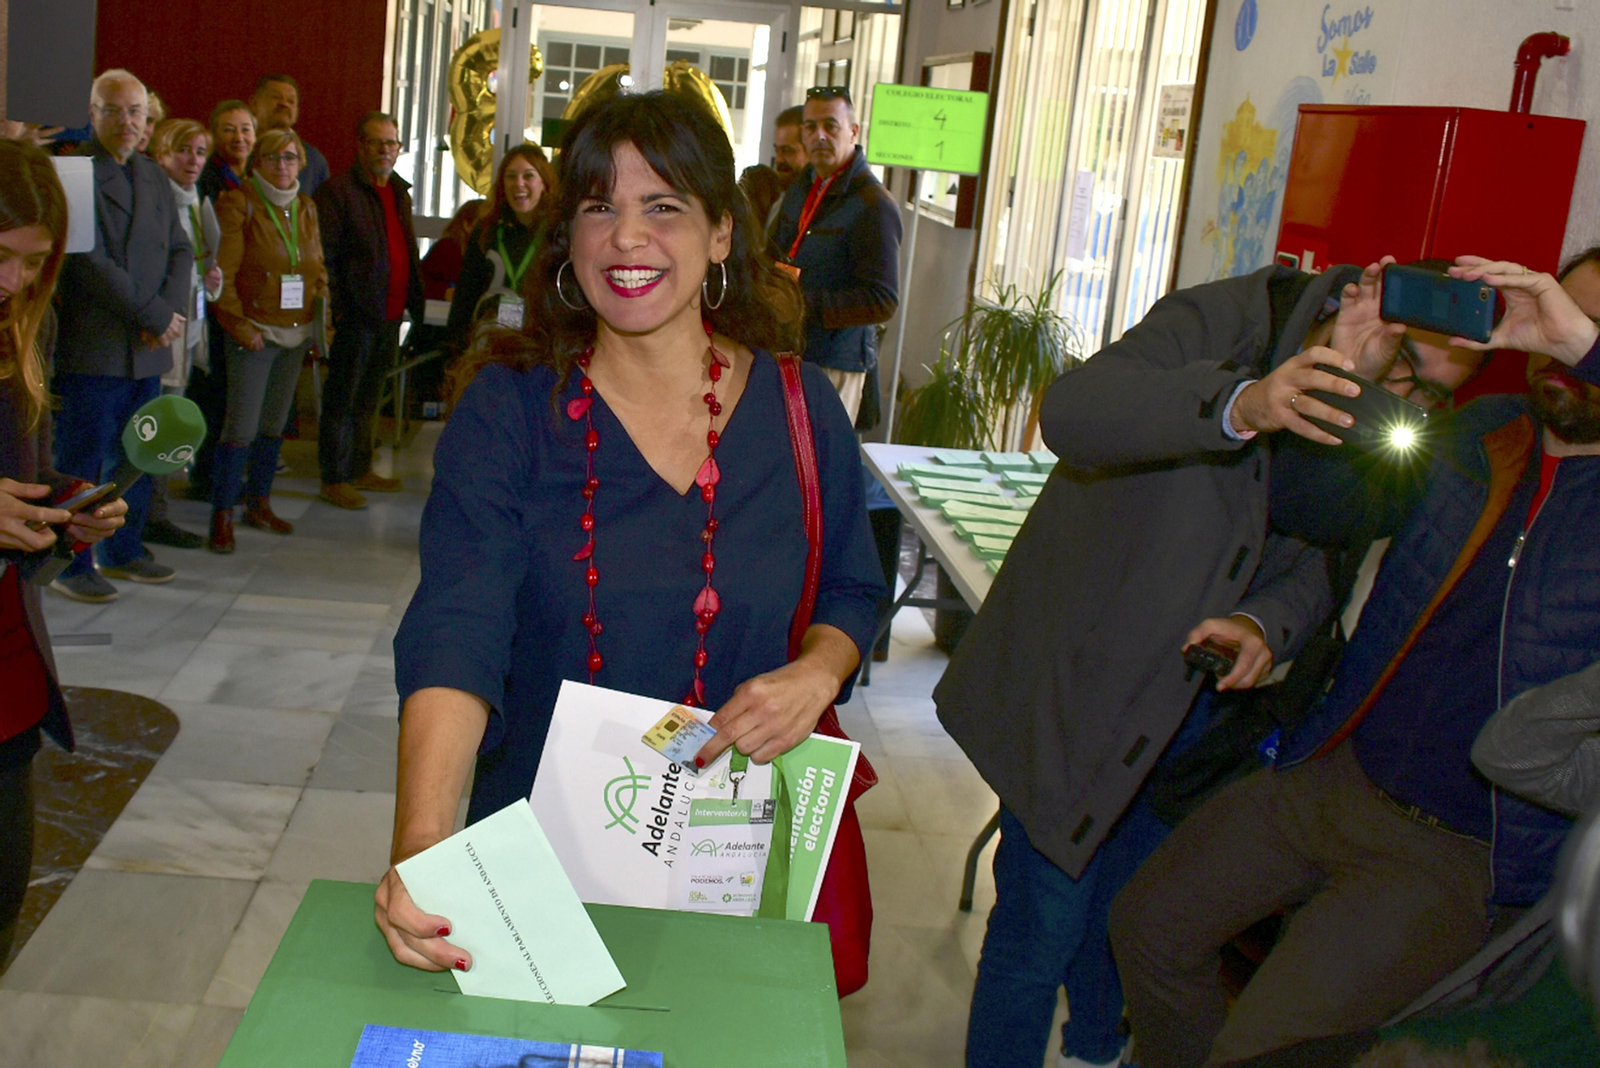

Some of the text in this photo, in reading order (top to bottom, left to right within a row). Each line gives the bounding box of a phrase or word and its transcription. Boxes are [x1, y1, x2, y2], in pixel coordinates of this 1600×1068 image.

[1317, 4, 1375, 54] Somos
[1322, 50, 1378, 77] La Salle
[886, 89, 974, 103] COLEGIO ELECTORAL
[878, 108, 947, 131] DISTRITO 4
[875, 140, 945, 161] SECCIONES 1
[641, 762, 682, 857] Adelante
[664, 772, 697, 868] ANDALUC
[694, 807, 748, 817] Interventor/a
[804, 767, 837, 852] electoral
[725, 841, 765, 851] Adelante
[465, 841, 493, 886] ANDALUCÍA
[487, 887, 499, 899] DE
[494, 898, 526, 952] PARLAMENTO
[528, 961, 555, 1005] LECCIONES
[406, 1038, 426, 1068] erno
